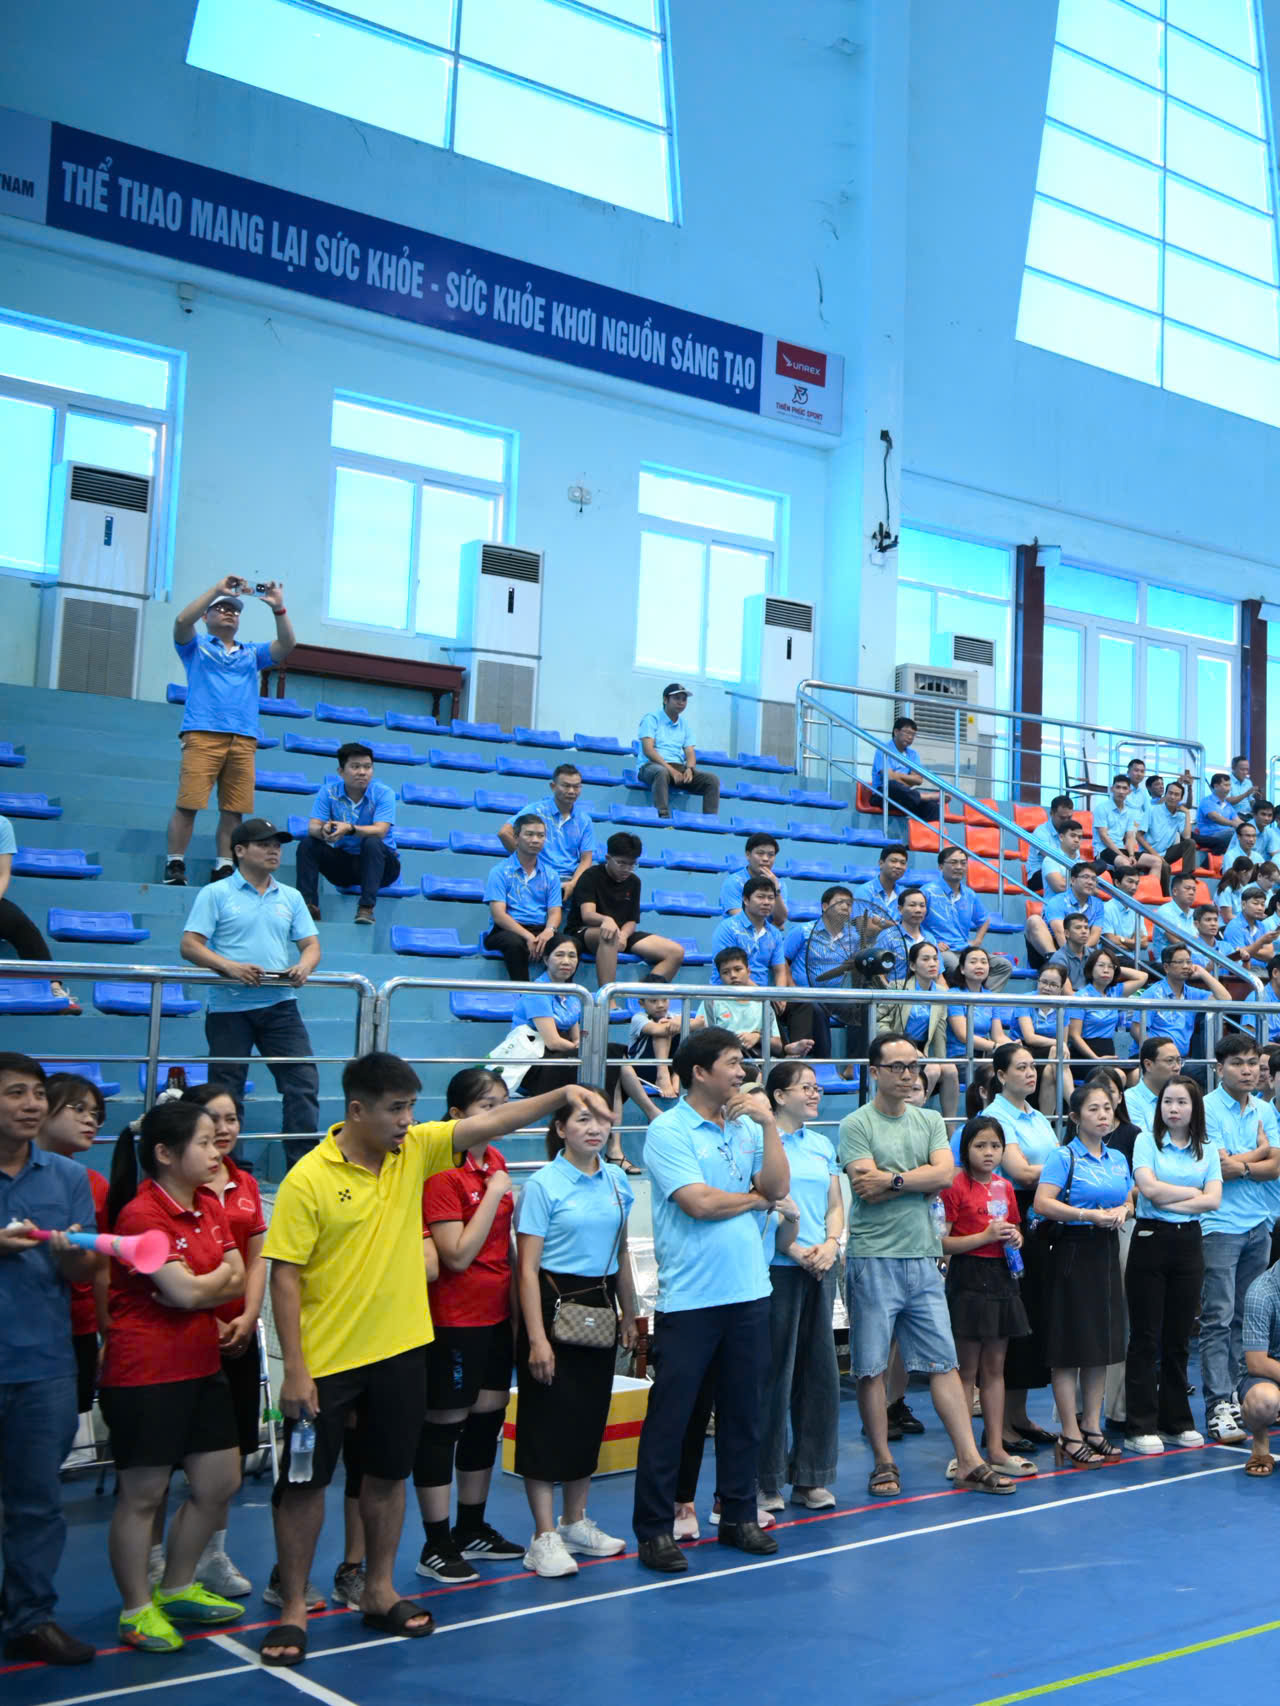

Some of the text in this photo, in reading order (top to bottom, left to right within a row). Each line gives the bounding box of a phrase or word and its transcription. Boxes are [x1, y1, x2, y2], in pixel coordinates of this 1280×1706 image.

[0, 173, 34, 198] NAM
[62, 156, 112, 213] THỂ
[118, 176, 182, 231] THAO
[190, 197, 264, 255] MANG
[271, 220, 308, 272] LẠI
[314, 231, 360, 281] SỨC
[367, 245, 424, 299] KHỎE
[446, 268, 487, 316] SỨC
[493, 281, 546, 333] KHỎE
[551, 301, 597, 347] KHƠI
[602, 317, 666, 366] NGUỒN
[671, 333, 719, 380] SÁNG
[724, 351, 755, 394] TẠO
